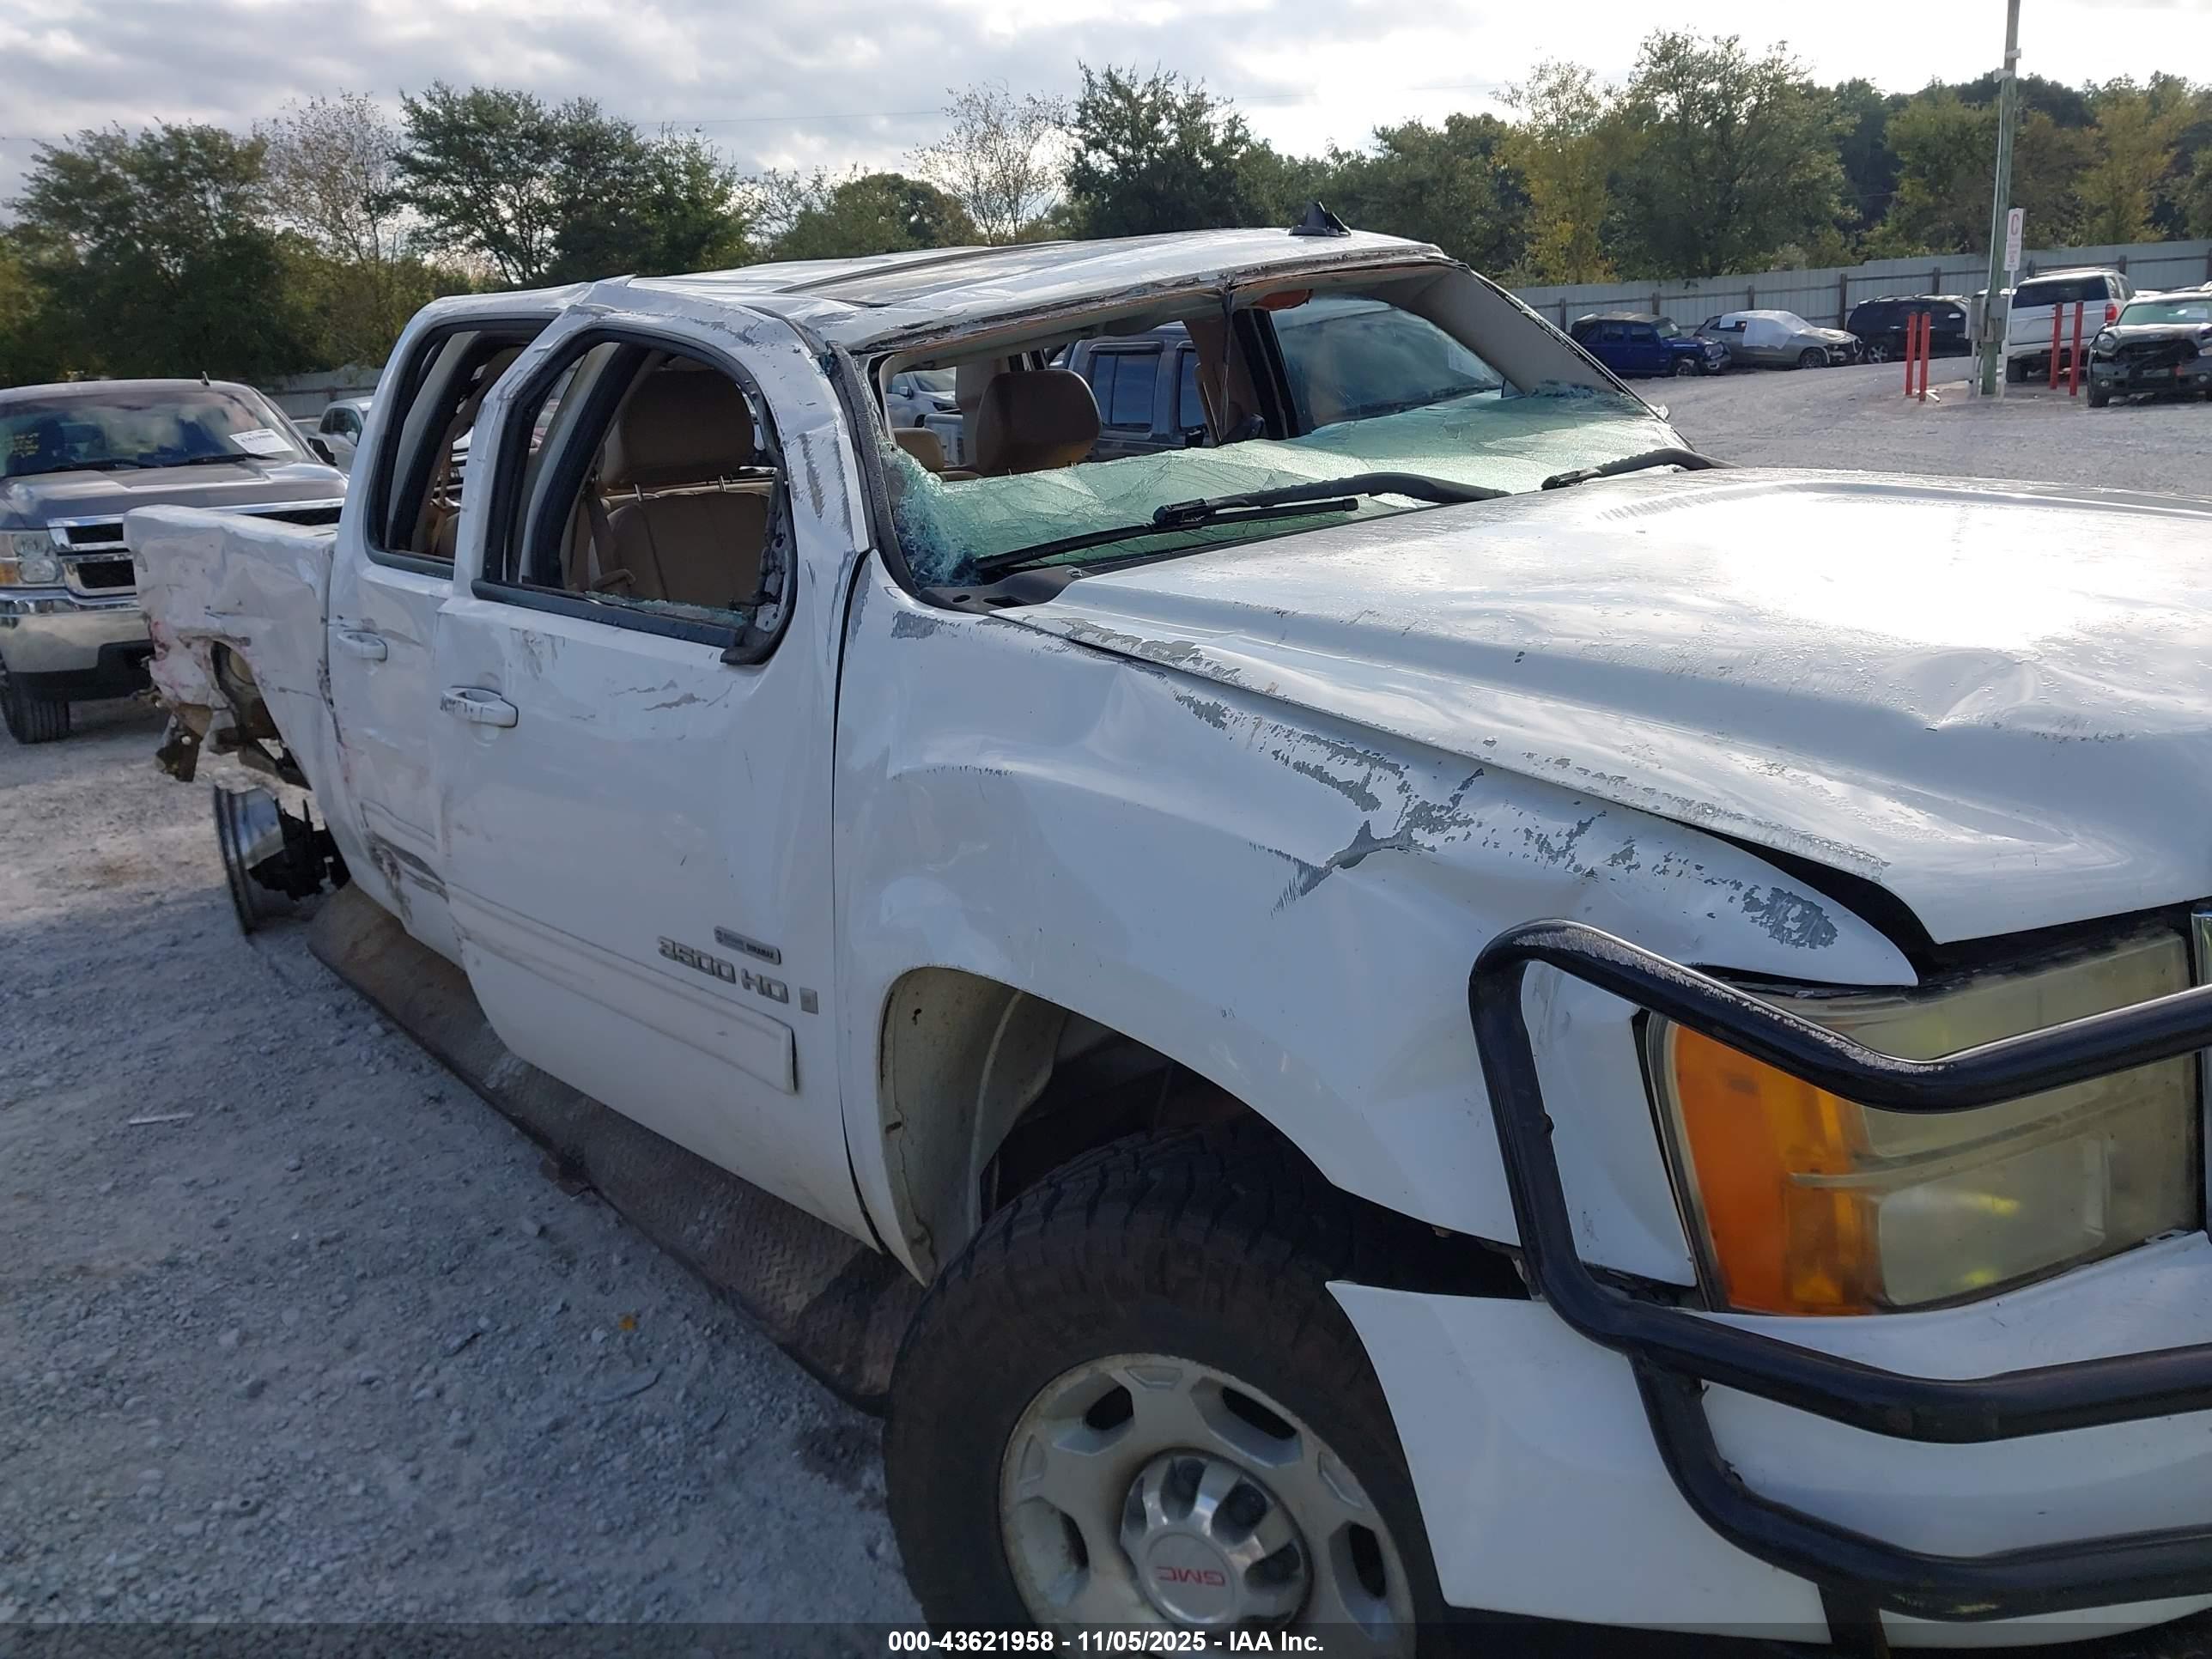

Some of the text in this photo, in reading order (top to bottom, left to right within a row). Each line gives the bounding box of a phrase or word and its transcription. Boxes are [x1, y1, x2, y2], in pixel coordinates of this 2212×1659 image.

[2011, 214, 2020, 235] C
[658, 935, 736, 985] 3500
[740, 968, 789, 1004] HD
[1156, 1565, 1225, 1587] GMC
